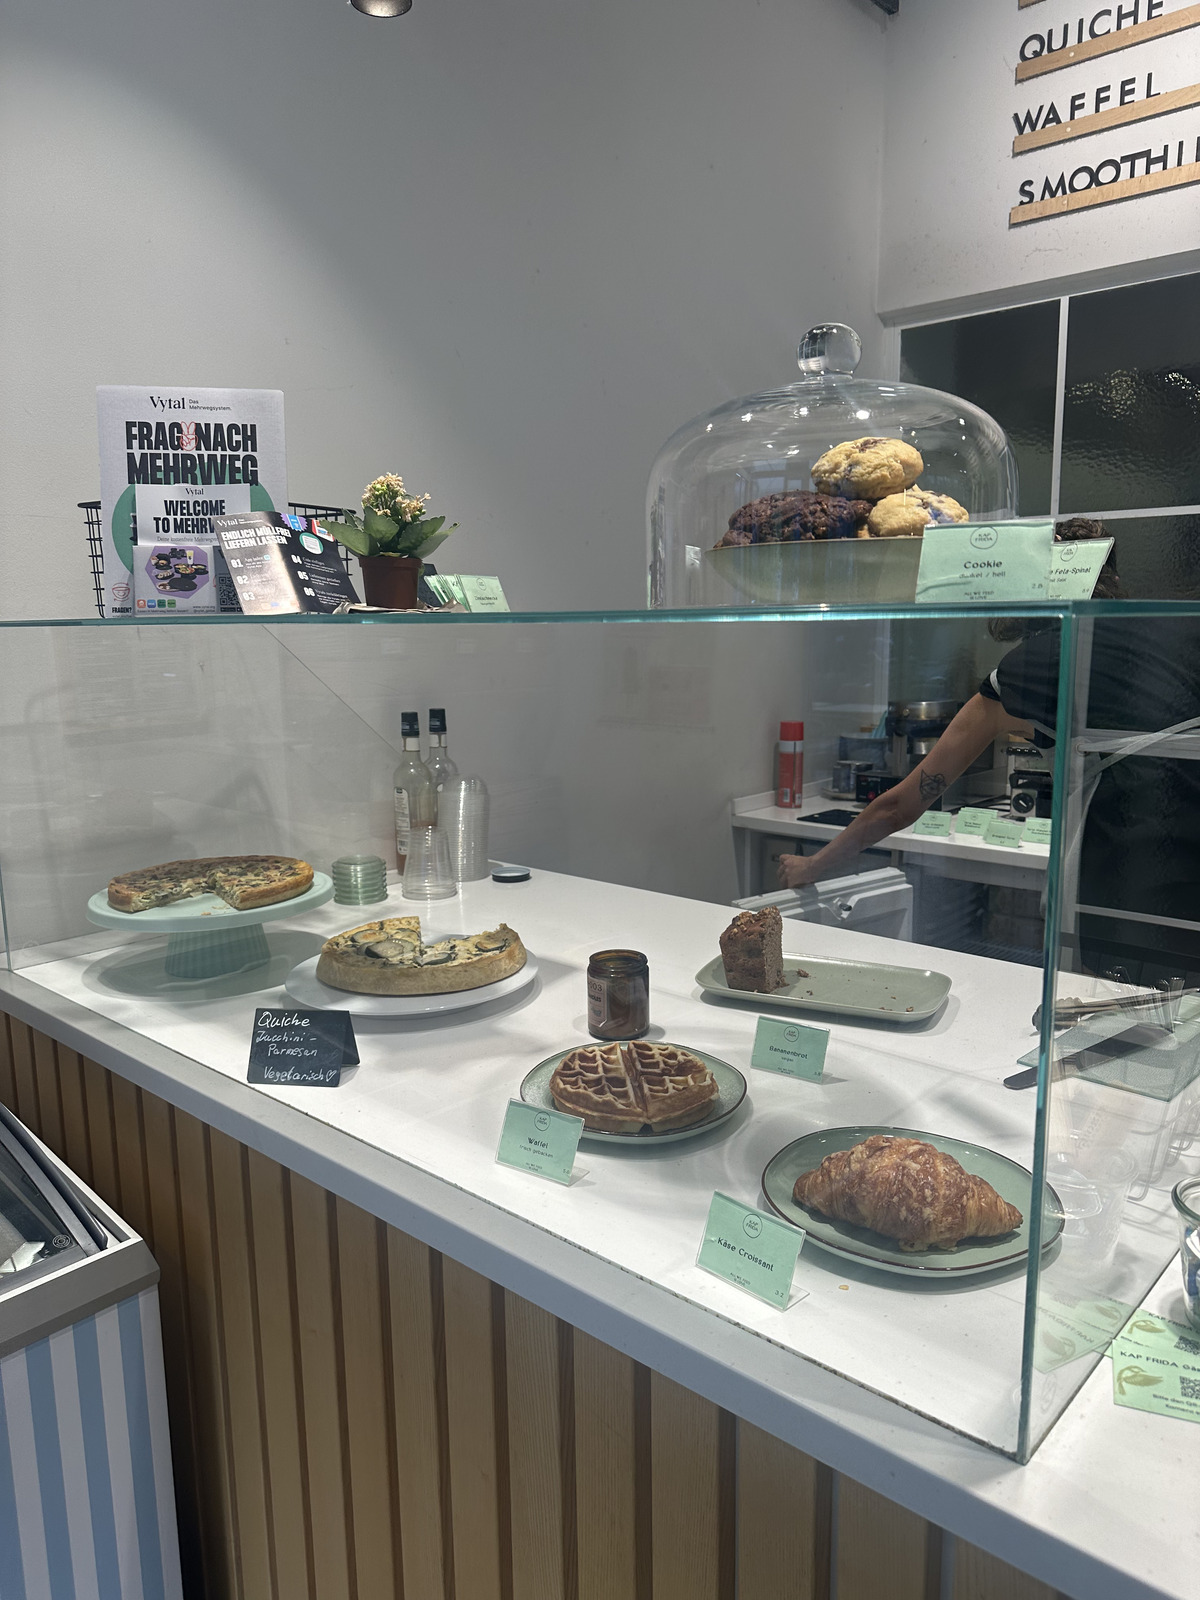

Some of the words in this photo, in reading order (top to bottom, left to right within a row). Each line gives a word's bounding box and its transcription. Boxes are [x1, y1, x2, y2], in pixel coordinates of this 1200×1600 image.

[1019, 0, 1164, 62] QUICHE
[1013, 72, 1161, 135] WAFFEL
[150, 396, 186, 412] Vytal
[125, 421, 182, 451] FRAG
[195, 423, 258, 452] NACH
[127, 452, 259, 487] MEHRWEG
[185, 488, 204, 496] Vytal
[164, 499, 226, 516] WELCOME
[154, 517, 170, 534] TO
[216, 518, 238, 528] Vytal
[221, 528, 256, 541] ENDLICH
[256, 526, 292, 538] MÜLLFREI
[224, 538, 258, 550] LIEFERN
[256, 536, 288, 546] LASSEN
[964, 560, 1002, 569] Cookie
[258, 1011, 310, 1028] Quiche
[268, 1044, 318, 1056] Parmesan
[769, 1046, 808, 1059] Bananenbrot
[264, 1066, 324, 1082] Vegetarisch
[528, 1136, 549, 1149] Waffel
[718, 1236, 737, 1252] Käse
[738, 1248, 774, 1272] Croissant
[1120, 1351, 1143, 1360] KAP
[1146, 1356, 1179, 1368] FRIDA
